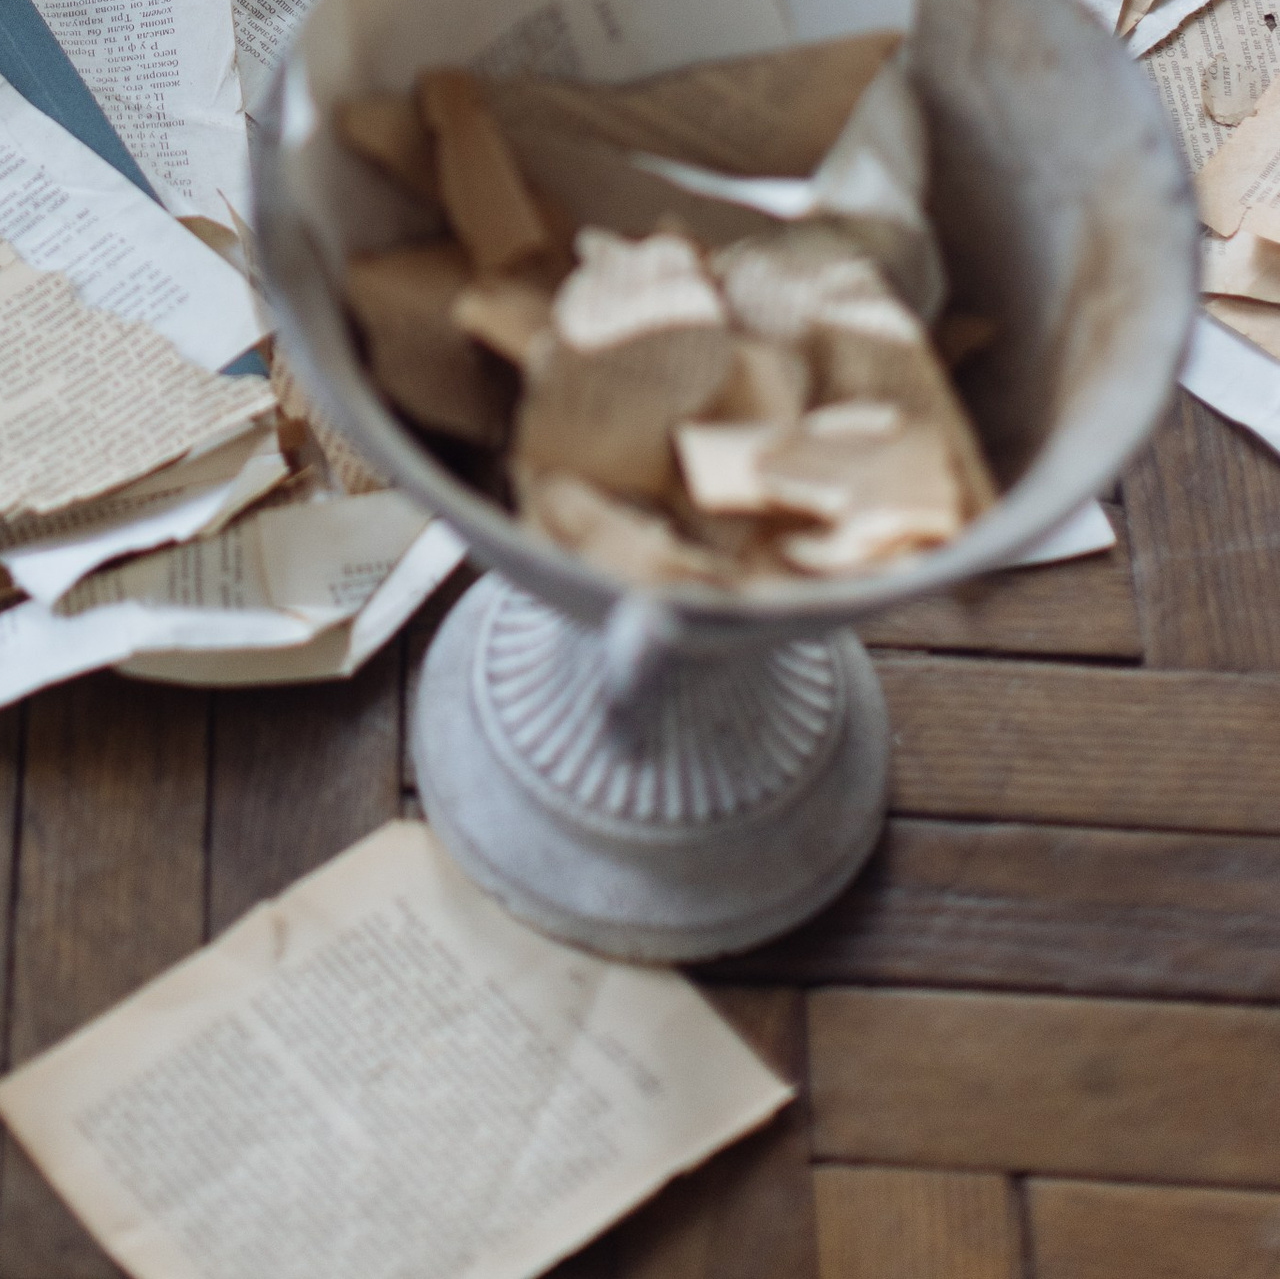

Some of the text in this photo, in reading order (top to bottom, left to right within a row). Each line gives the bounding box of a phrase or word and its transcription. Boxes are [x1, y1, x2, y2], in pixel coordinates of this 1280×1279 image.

[135, 26, 175, 39] смысла
[139, 16, 174, 29] ционы
[1169, 59, 1195, 131] старческое лицо
[1182, 65, 1200, 99] головой
[1193, 102, 1207, 129] повел
